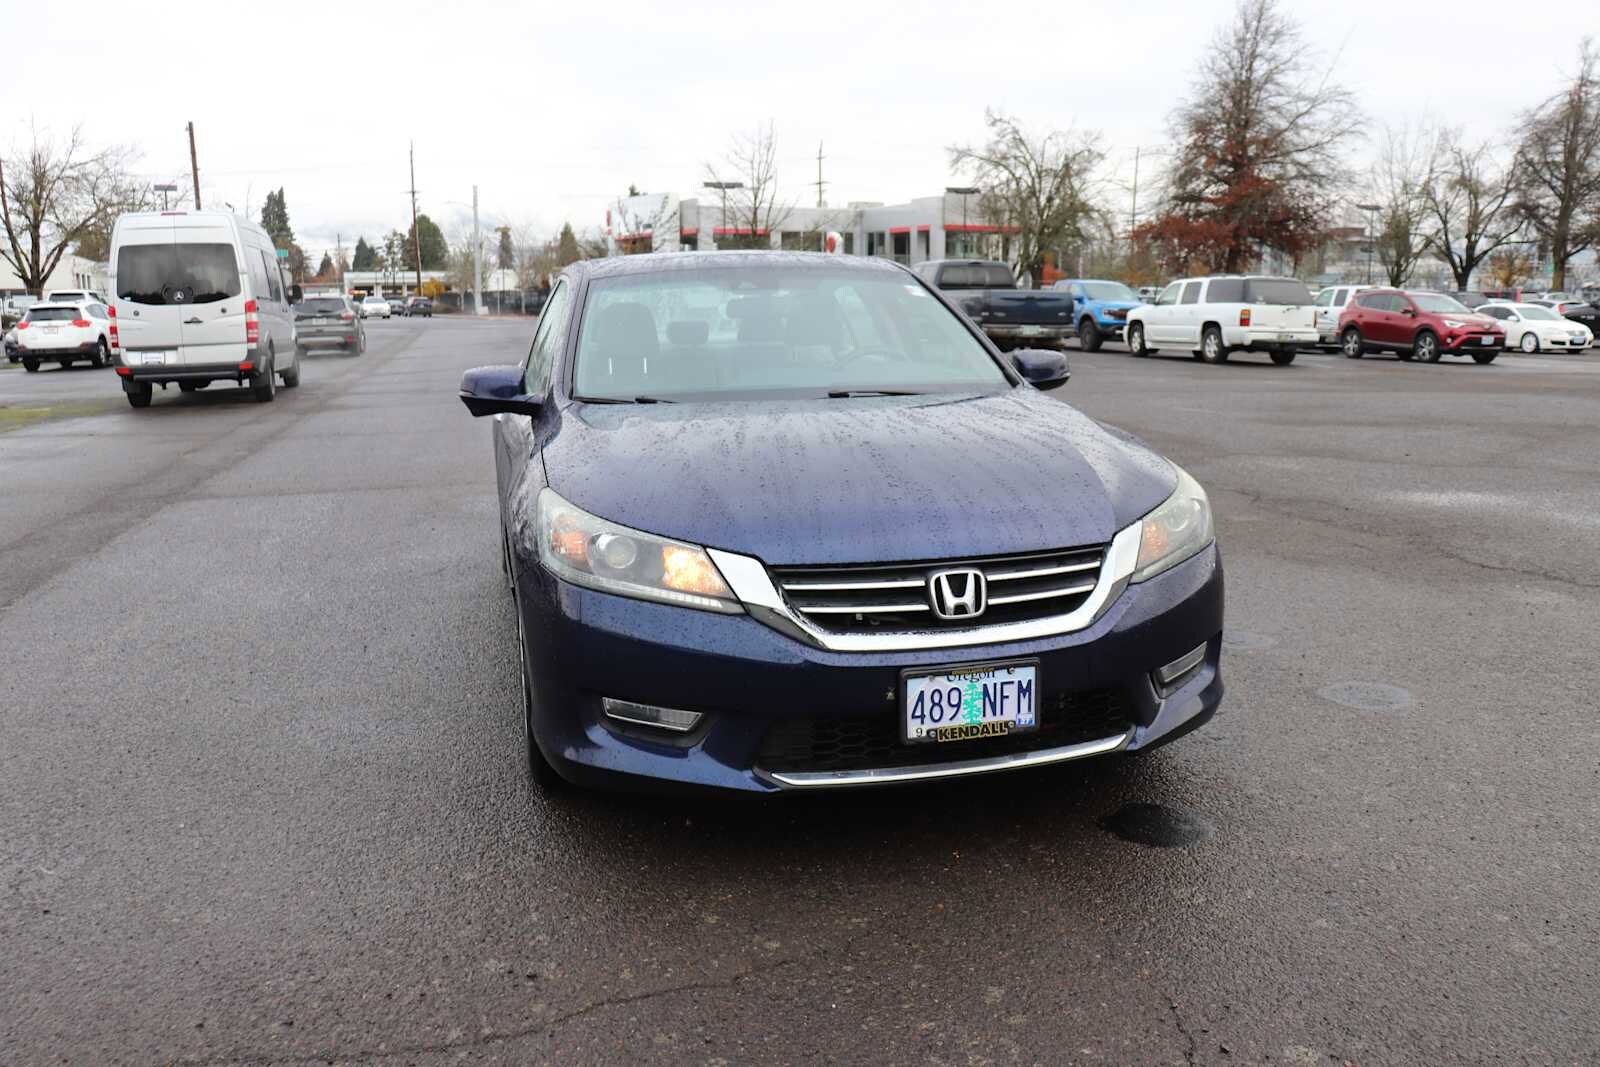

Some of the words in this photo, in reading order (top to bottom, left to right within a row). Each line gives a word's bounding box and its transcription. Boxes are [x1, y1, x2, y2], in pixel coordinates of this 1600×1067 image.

[911, 687, 962, 725] 489
[982, 679, 1032, 717] NFM
[937, 721, 1008, 742] KENDALL
